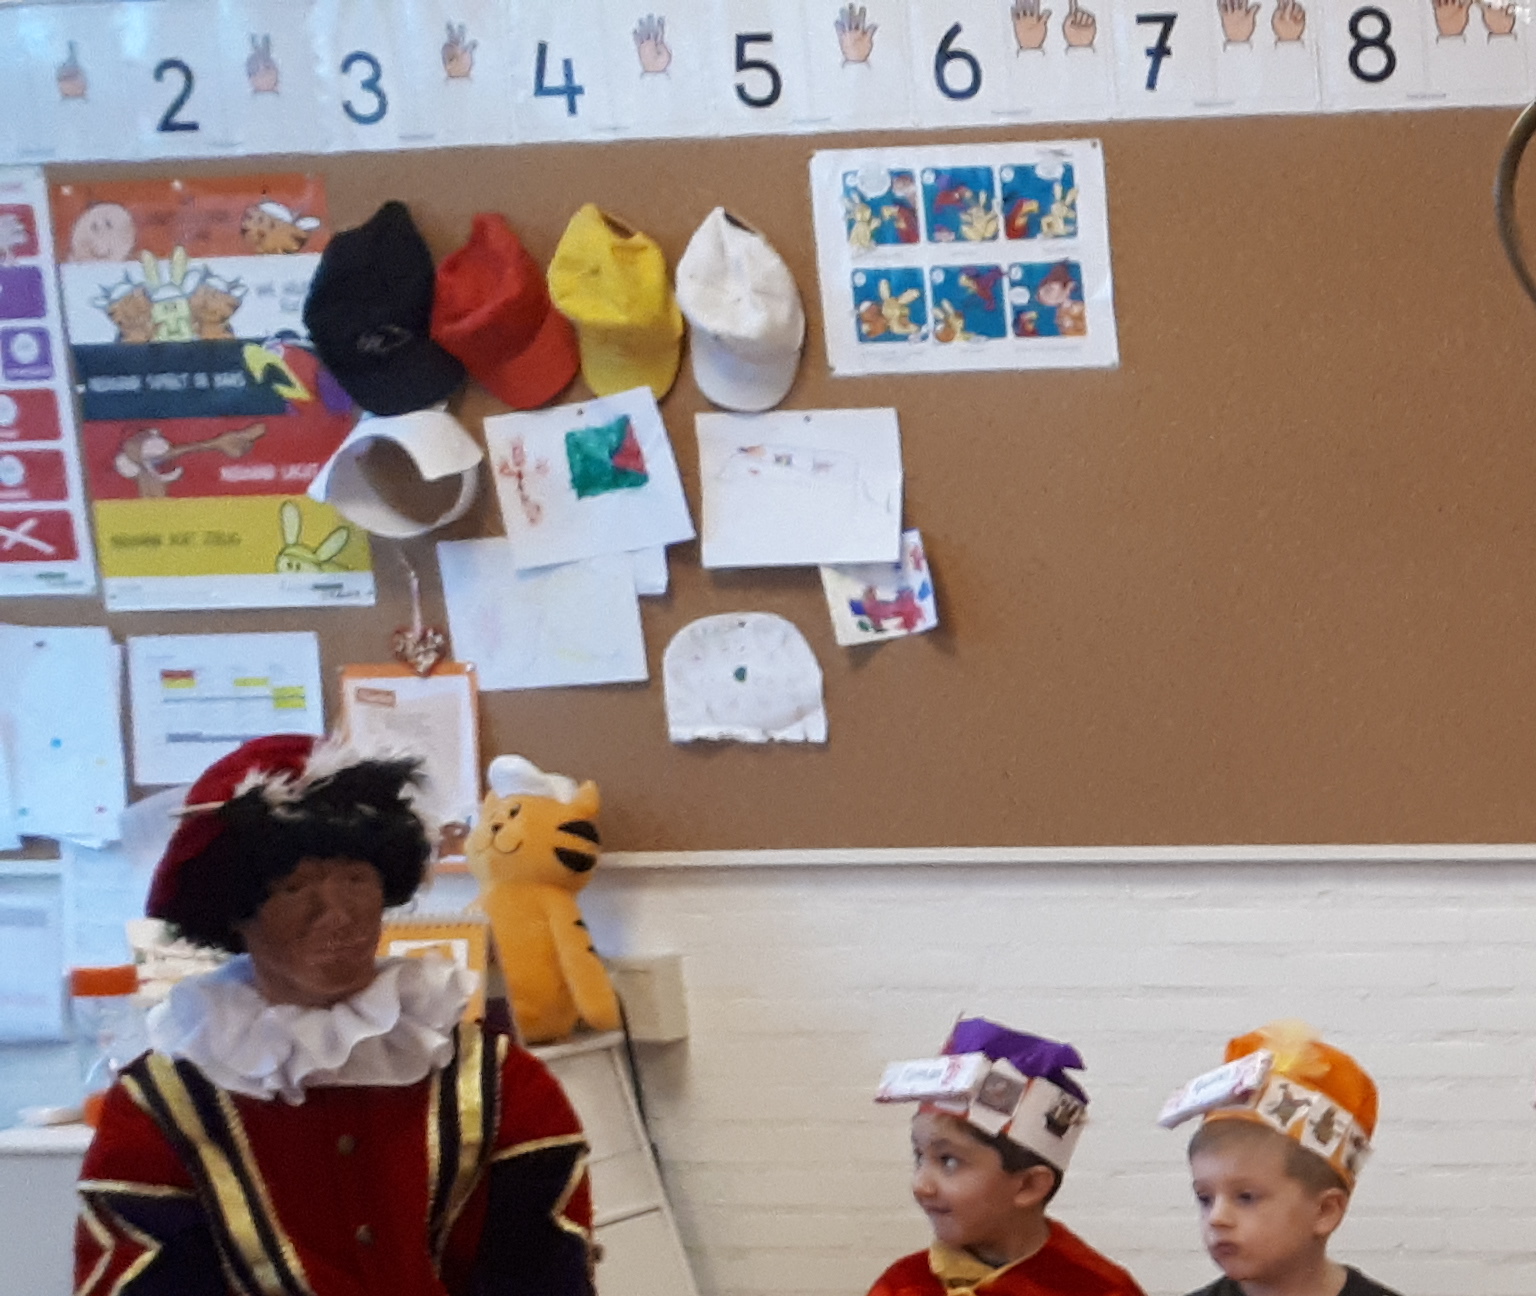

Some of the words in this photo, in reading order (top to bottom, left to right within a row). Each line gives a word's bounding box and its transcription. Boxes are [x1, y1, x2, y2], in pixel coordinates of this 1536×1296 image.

[533, 41, 585, 115] 4
[734, 32, 783, 108] 5
[934, 23, 983, 100] 6
[1135, 13, 1178, 91] 7
[1348, 6, 1397, 82] 8
[154, 59, 199, 132] 2
[340, 50, 389, 124] 3
